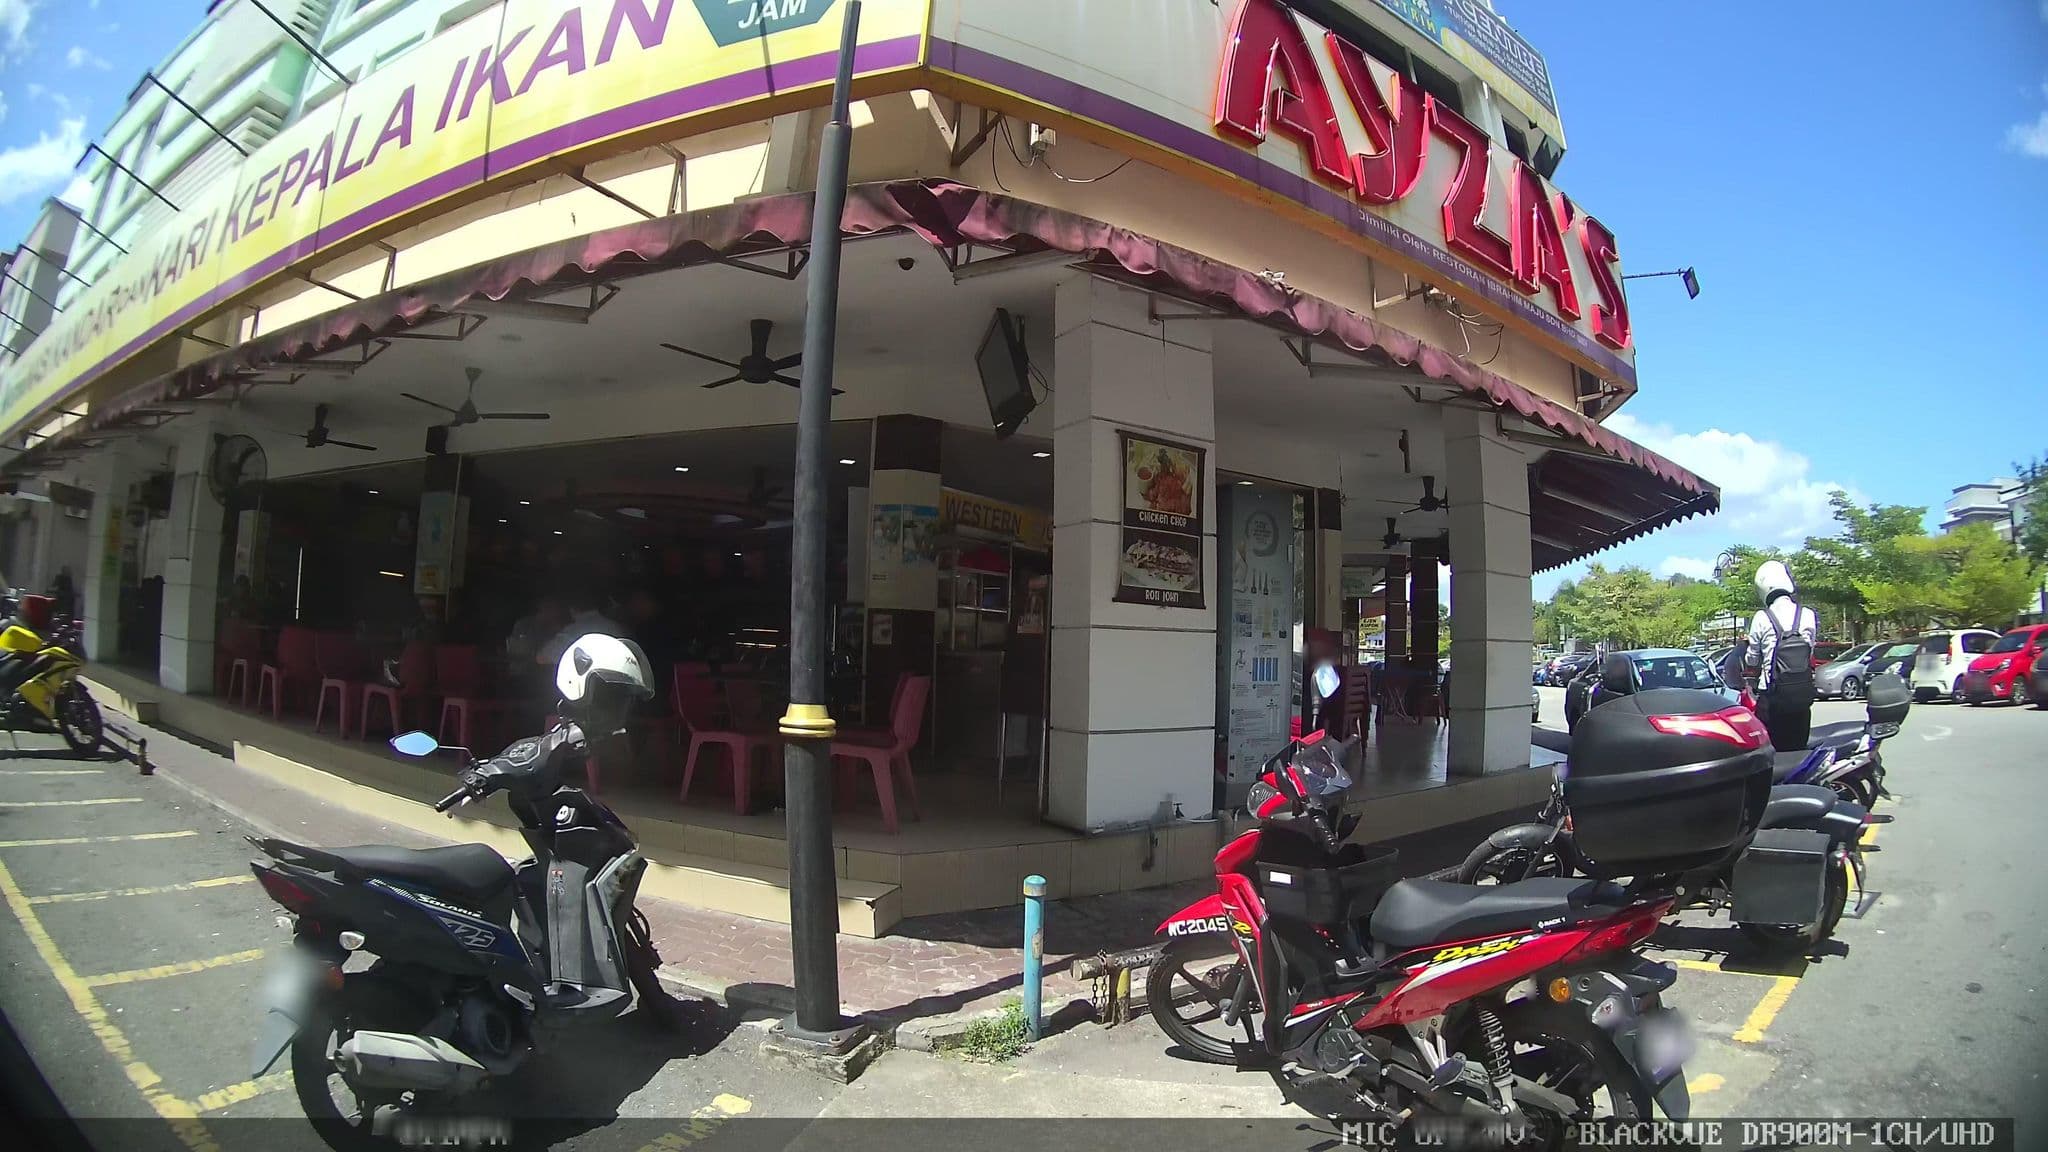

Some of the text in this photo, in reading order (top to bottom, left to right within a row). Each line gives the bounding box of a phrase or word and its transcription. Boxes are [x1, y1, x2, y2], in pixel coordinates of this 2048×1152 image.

[738, 0, 806, 29] JAM
[149, 207, 219, 297] KARI
[217, 84, 414, 255] KEPALA
[435, 0, 674, 131] IKAN
[1402, 231, 1431, 255] Oleh:
[1432, 248, 1487, 286] RESTORAN
[1486, 279, 1524, 307] IBRAHIM
[1522, 301, 1546, 319] MAJU
[1545, 315, 1562, 330] SDN
[945, 495, 1023, 534] WESTERN
[1168, 917, 1228, 937] WC2045
